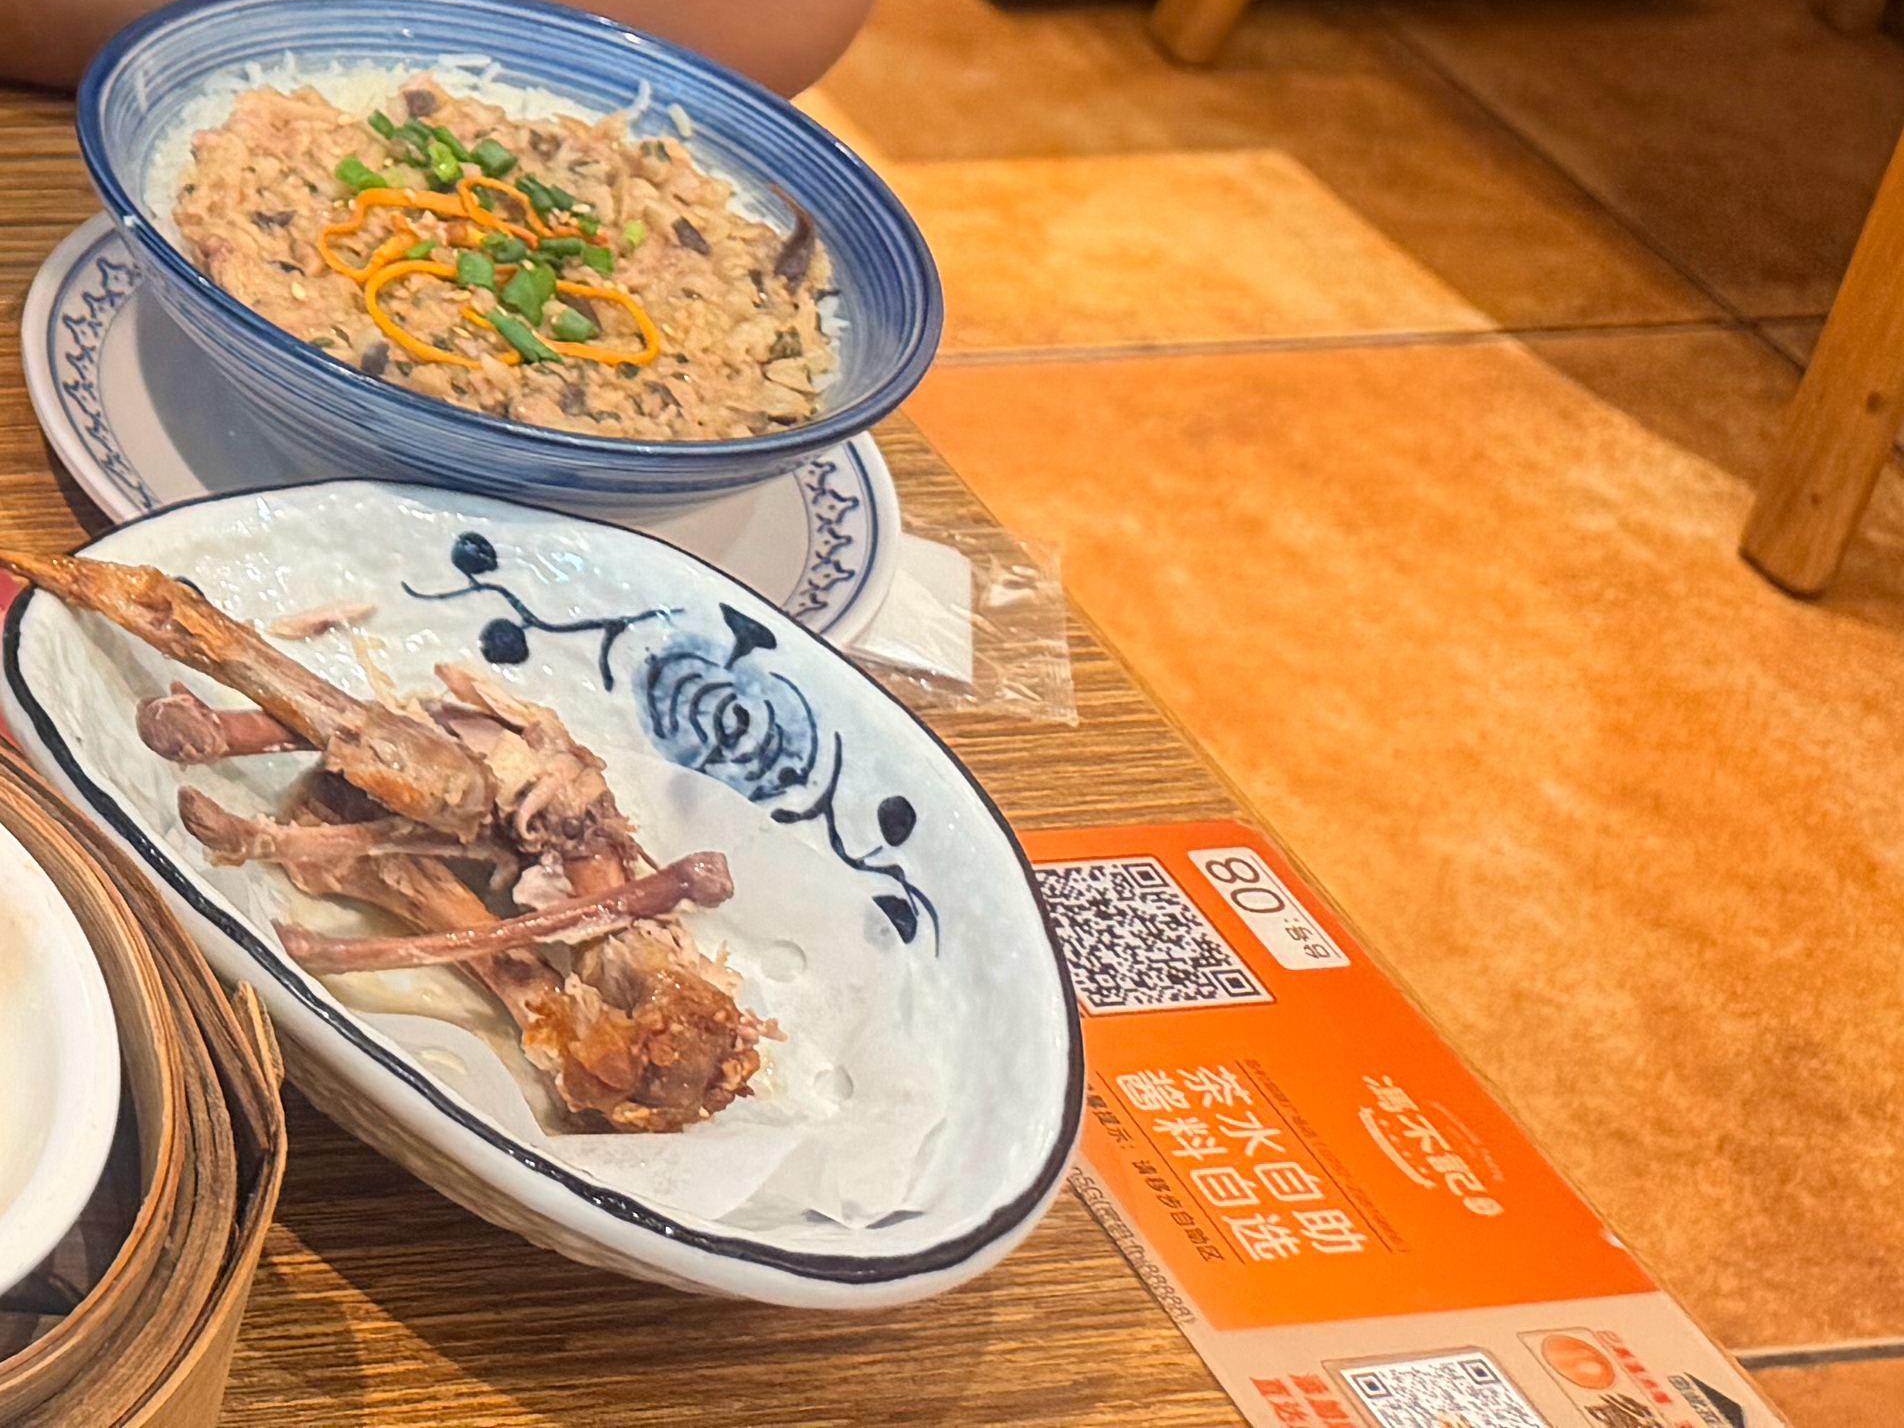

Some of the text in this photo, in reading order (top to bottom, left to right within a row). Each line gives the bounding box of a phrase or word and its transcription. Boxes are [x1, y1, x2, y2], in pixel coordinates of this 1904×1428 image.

[1204, 855, 1285, 917] 80
[1114, 1070, 1301, 1263] 酱料自选
[1182, 1064, 1367, 1258] 茶水自助
